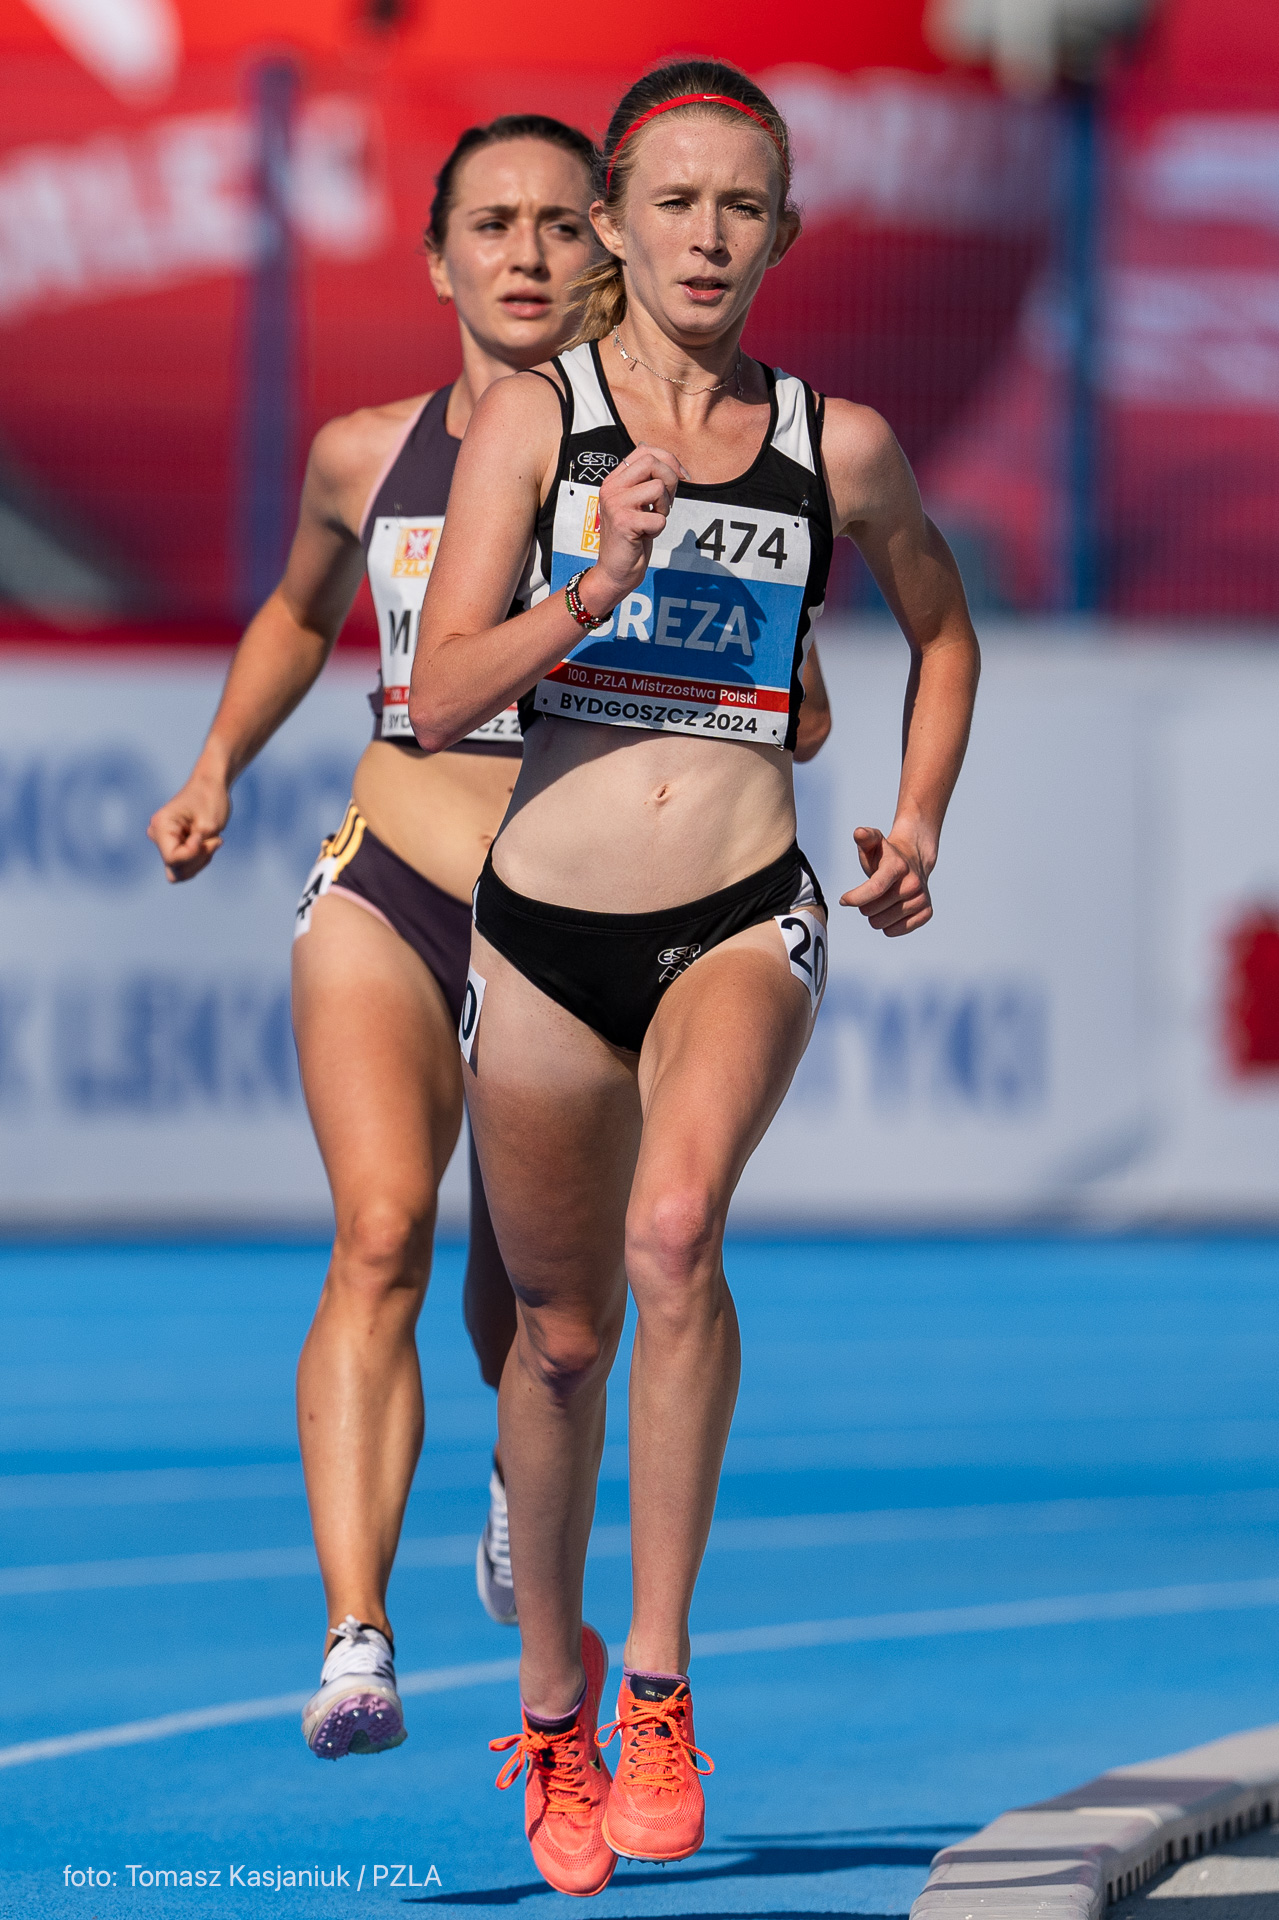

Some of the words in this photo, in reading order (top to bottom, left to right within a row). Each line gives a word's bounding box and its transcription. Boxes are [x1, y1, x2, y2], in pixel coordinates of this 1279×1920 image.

[695, 518, 788, 570] 474
[567, 667, 591, 684] 100.
[594, 674, 628, 689] PZLA
[631, 678, 716, 700] Mistrzostwa
[719, 688, 758, 705] Polski
[559, 692, 699, 727] BYDGOSZCZ
[703, 711, 758, 735] 2024
[780, 916, 825, 996] 20
